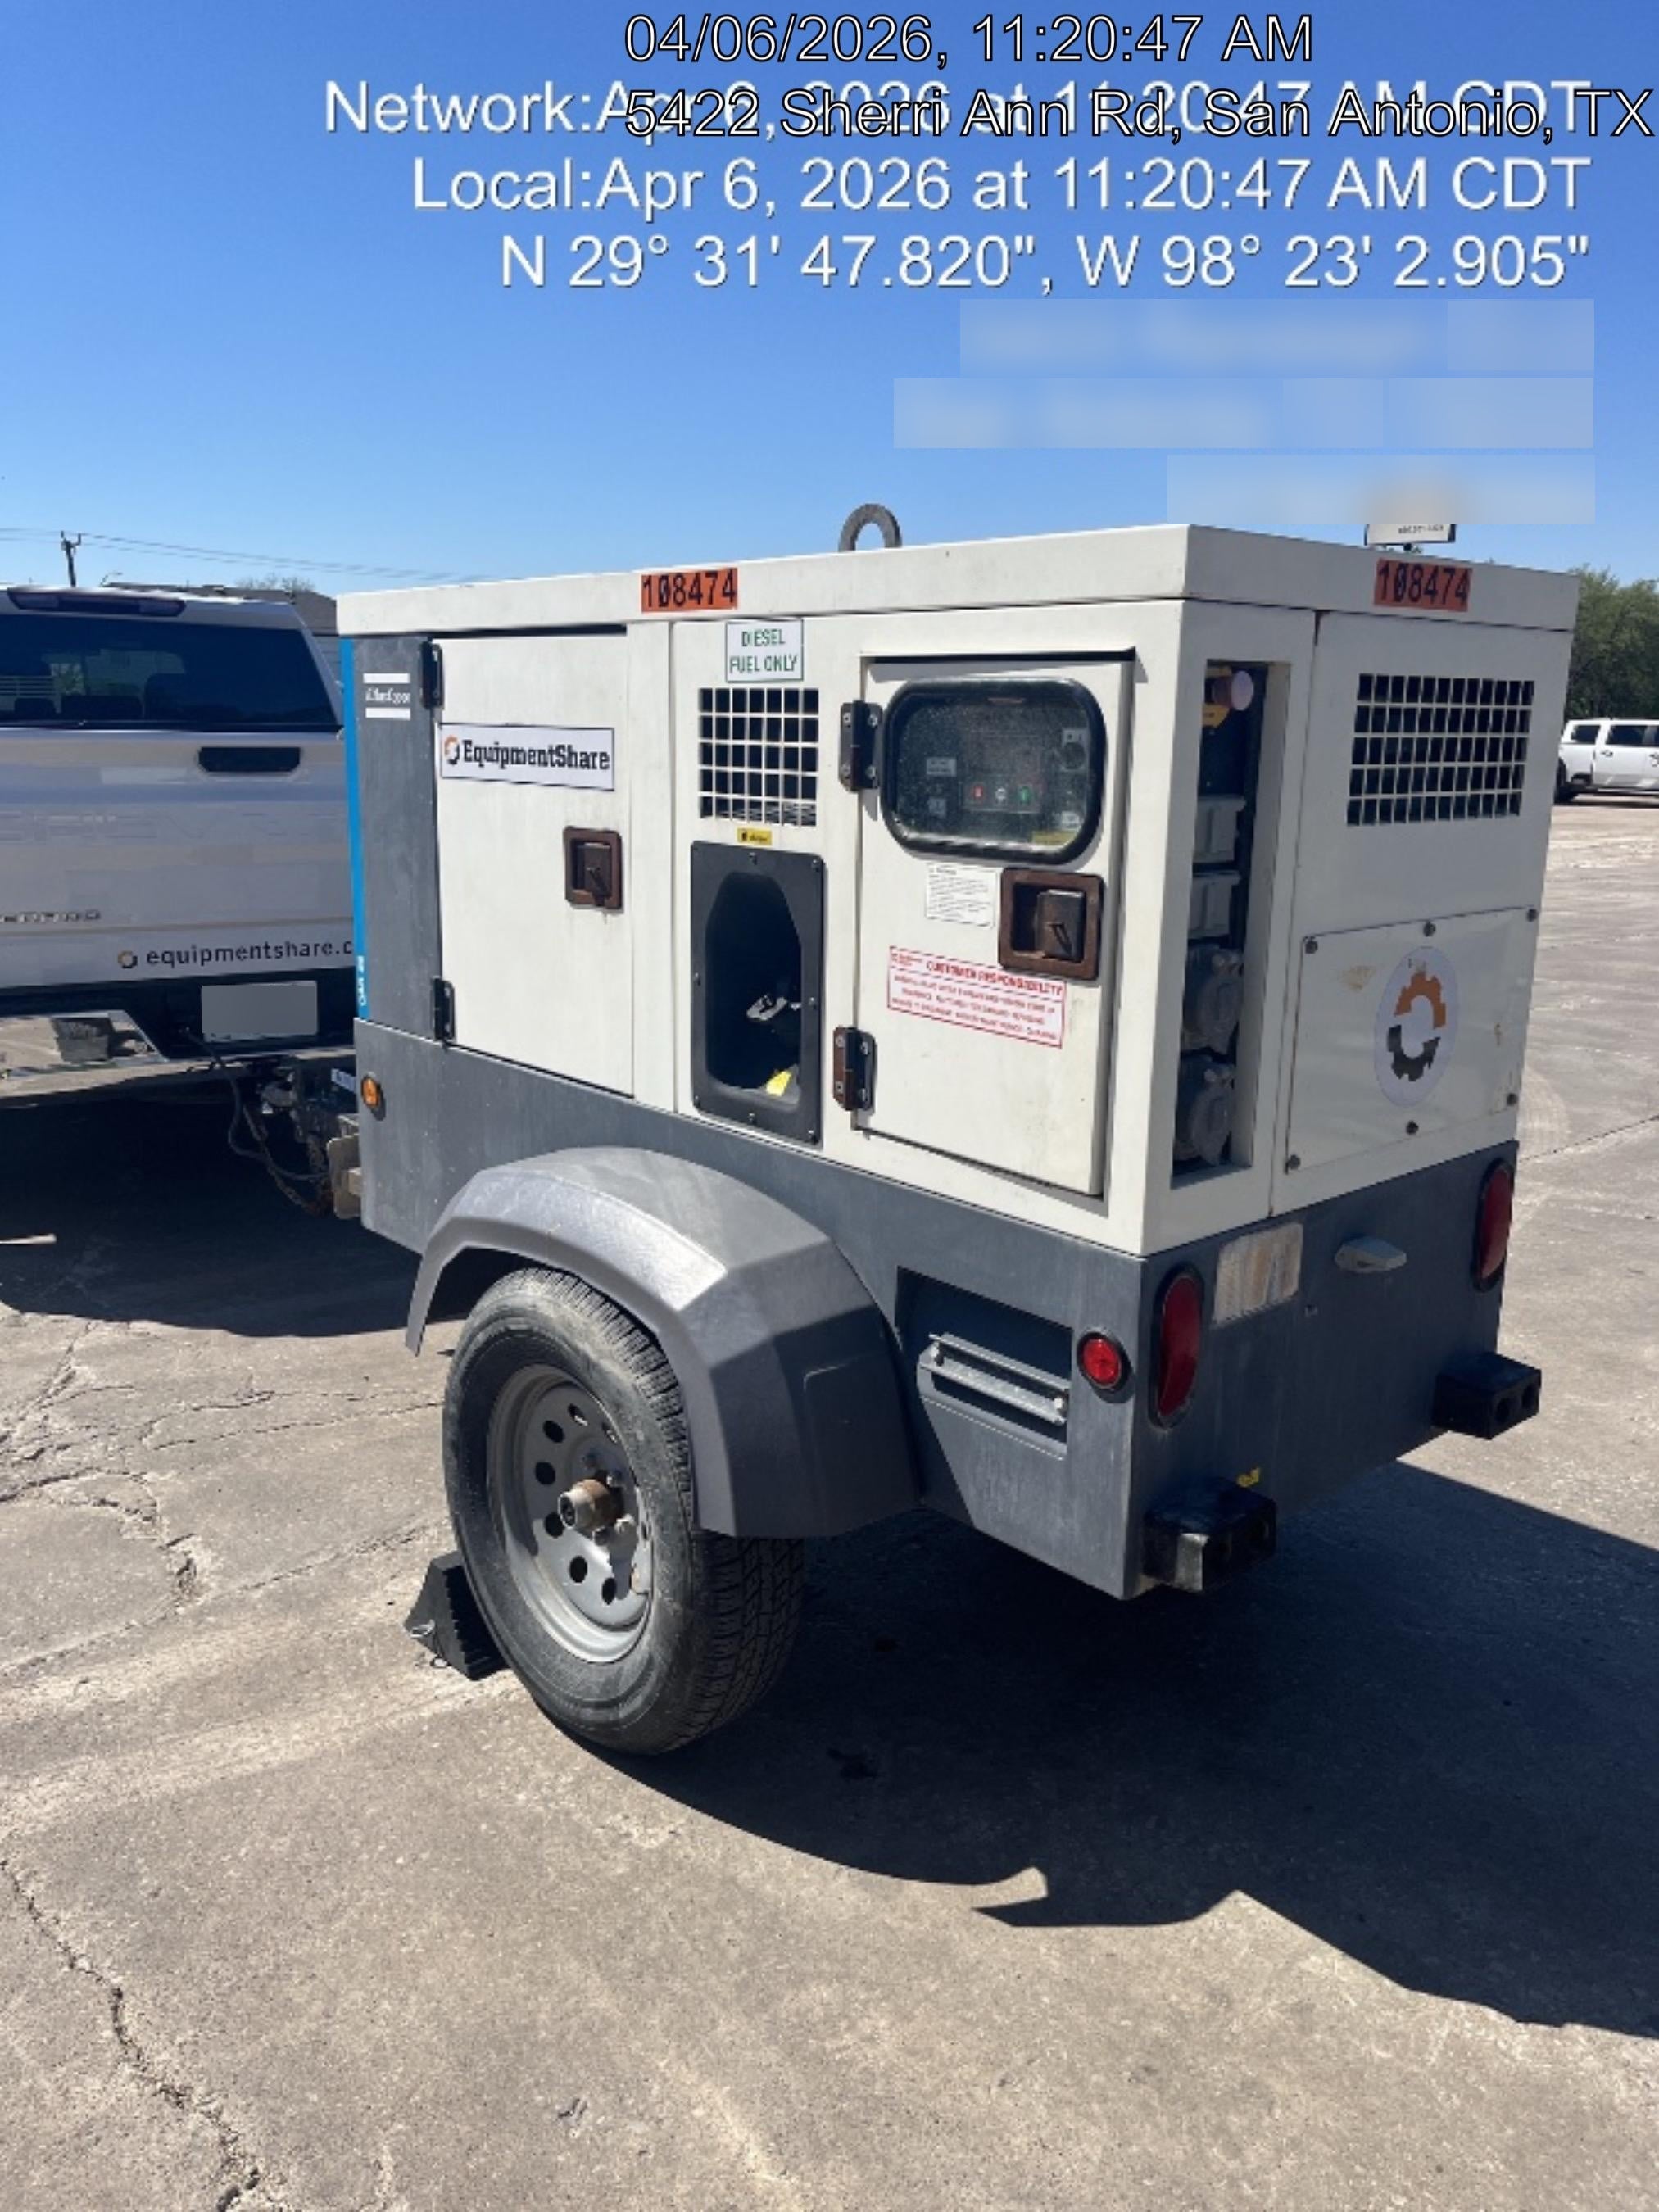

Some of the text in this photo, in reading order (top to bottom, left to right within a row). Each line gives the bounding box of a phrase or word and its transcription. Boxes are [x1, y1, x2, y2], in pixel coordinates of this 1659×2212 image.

[642, 568, 737, 608] 108474
[1378, 560, 1470, 605] 108474
[741, 628, 786, 647] DIESEL
[729, 653, 798, 674] FUEL ONLY
[462, 740, 610, 770] EquipmentShare
